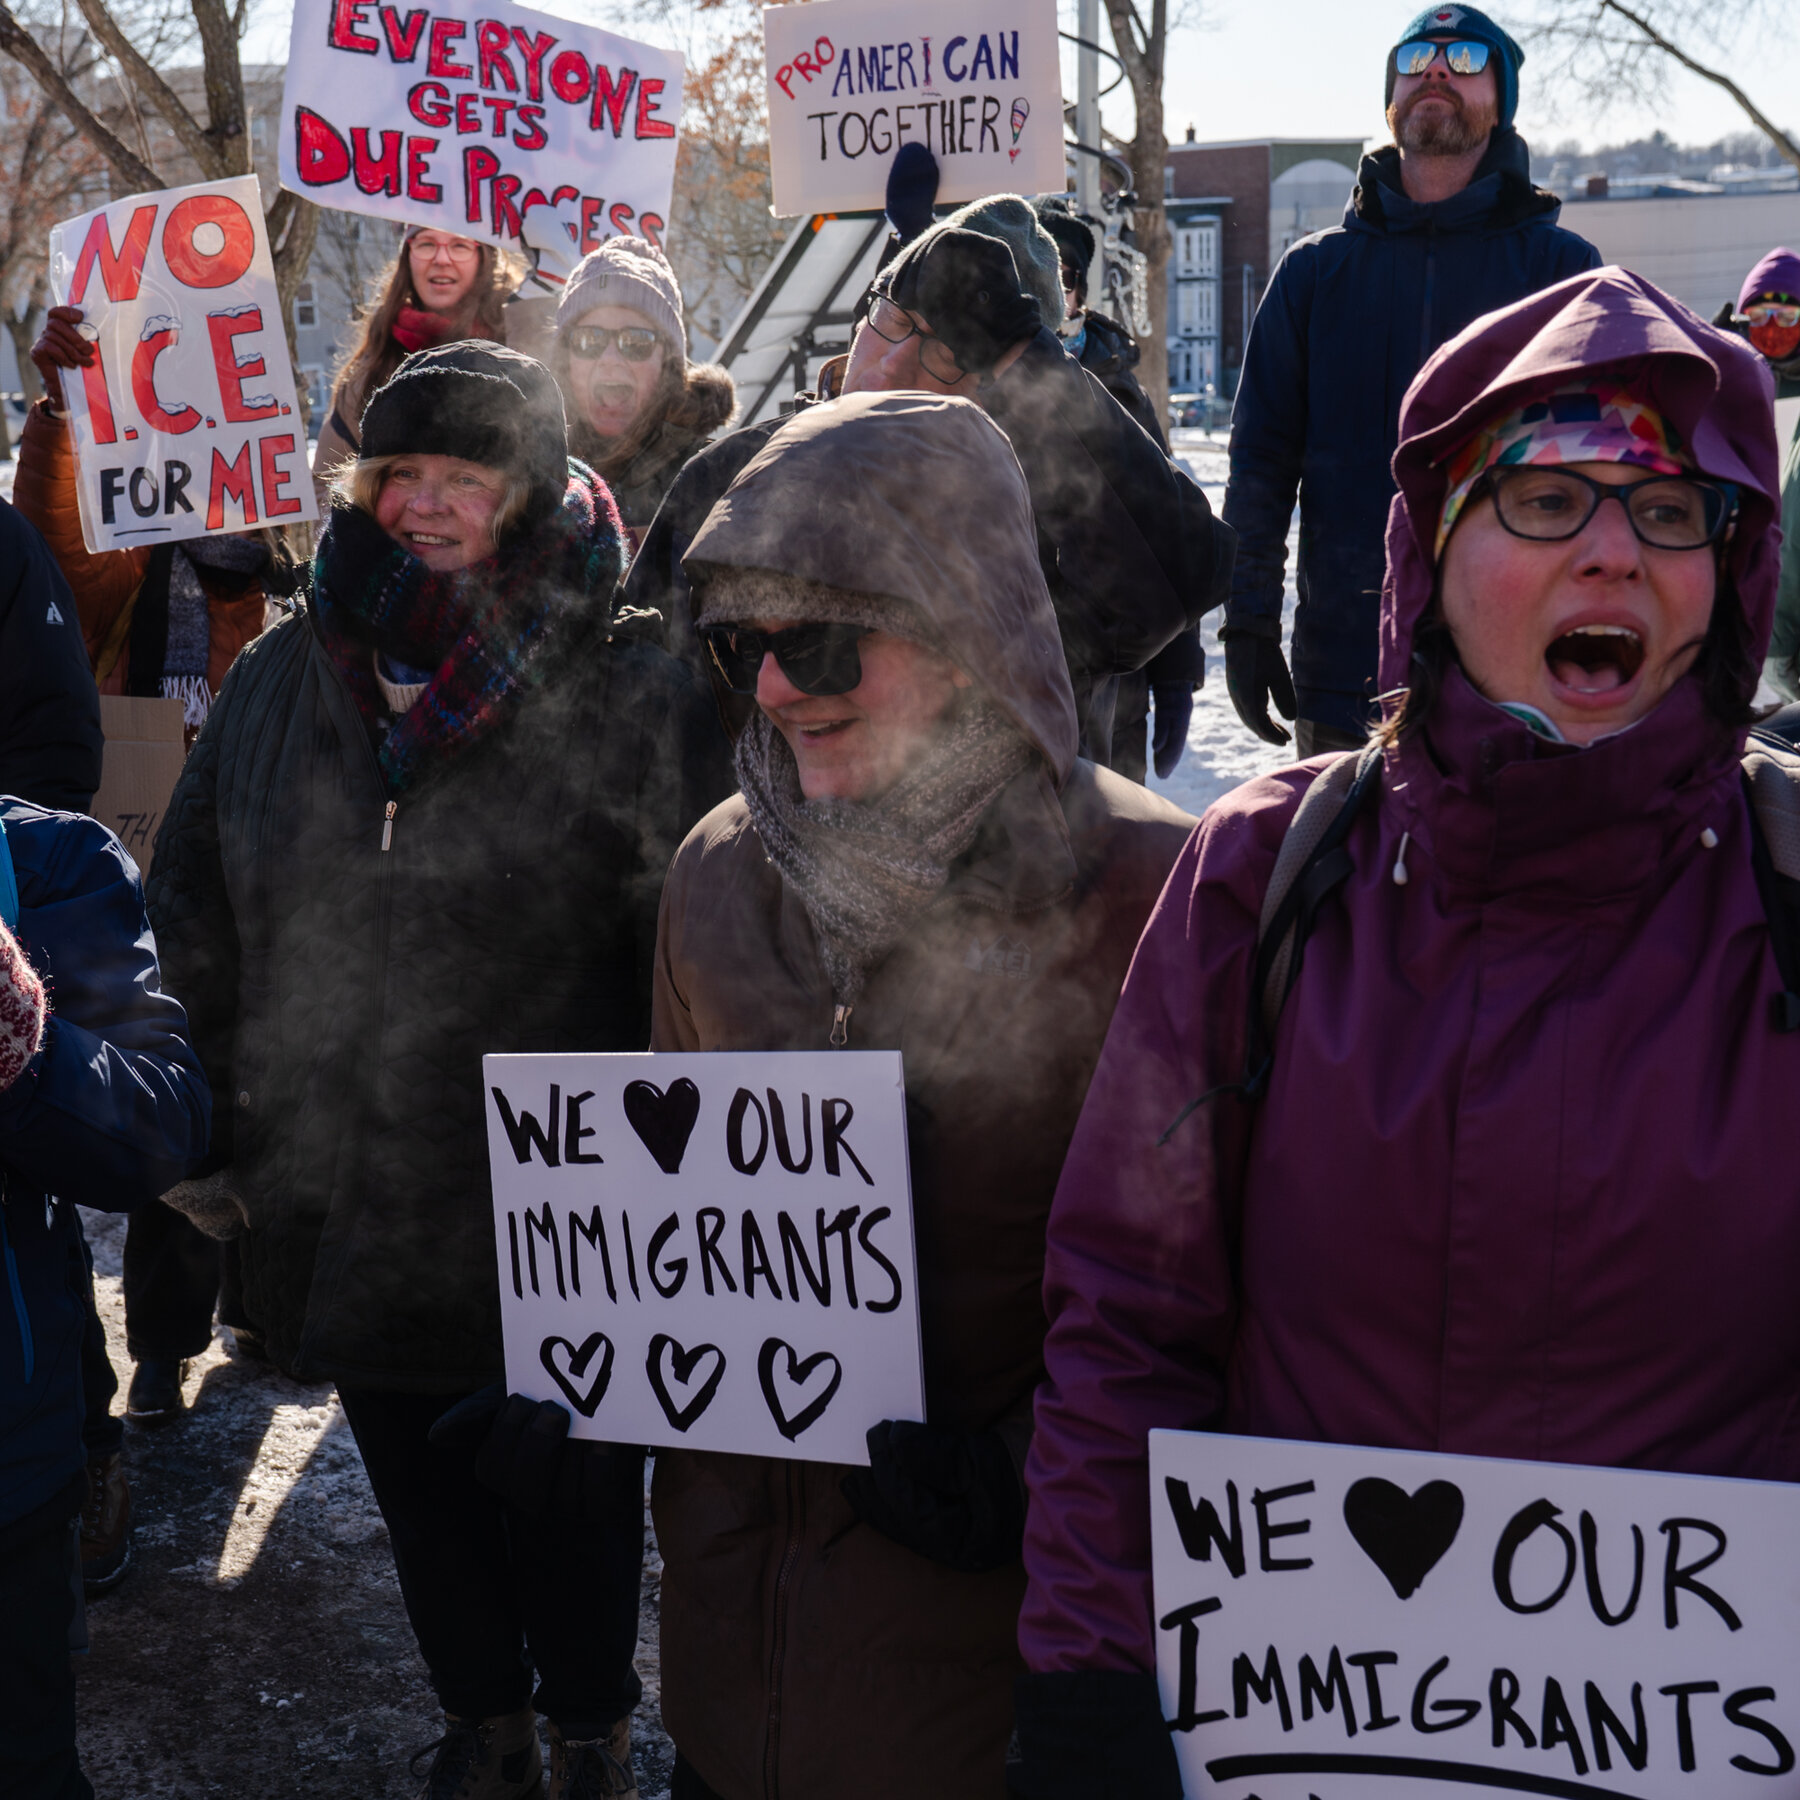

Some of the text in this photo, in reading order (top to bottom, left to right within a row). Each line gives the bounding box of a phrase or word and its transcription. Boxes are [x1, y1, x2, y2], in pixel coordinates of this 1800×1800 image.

[328, 0, 676, 139] EVERYONE
[407, 81, 549, 151] GETS
[774, 30, 1019, 100] PRO AMERICAN
[296, 105, 443, 203] DUE
[68, 195, 255, 306] NO
[76, 303, 292, 444] I.C.E.
[100, 434, 302, 531] FOR ME
[491, 1083, 875, 1186] WE OUR
[507, 1201, 902, 1313] IMMIGRANTS
[1164, 1476, 1743, 1632] WE OUR
[1159, 1597, 1795, 1776] IMMIGRANTS
